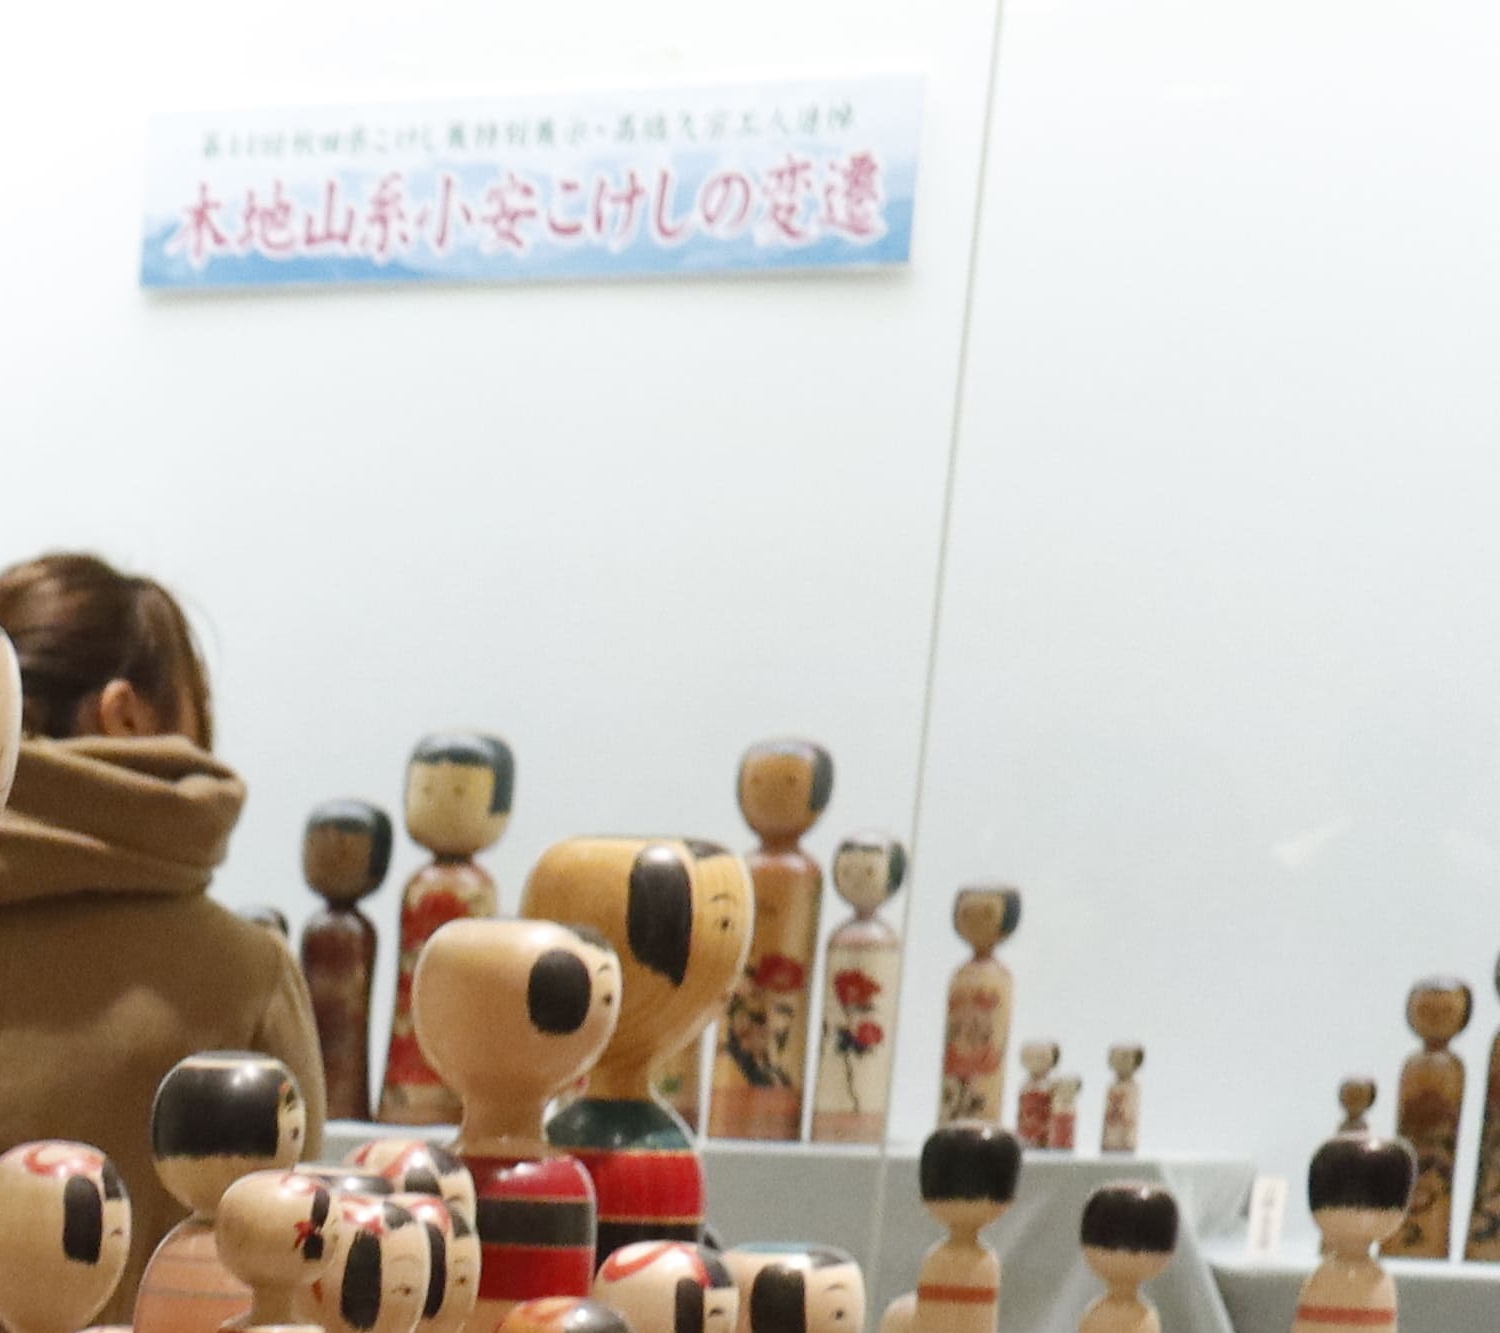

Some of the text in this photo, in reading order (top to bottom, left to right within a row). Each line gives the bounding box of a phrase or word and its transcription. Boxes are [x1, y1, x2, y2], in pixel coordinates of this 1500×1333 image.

[174, 152, 882, 260] 木地山系小安こけしの変遷
